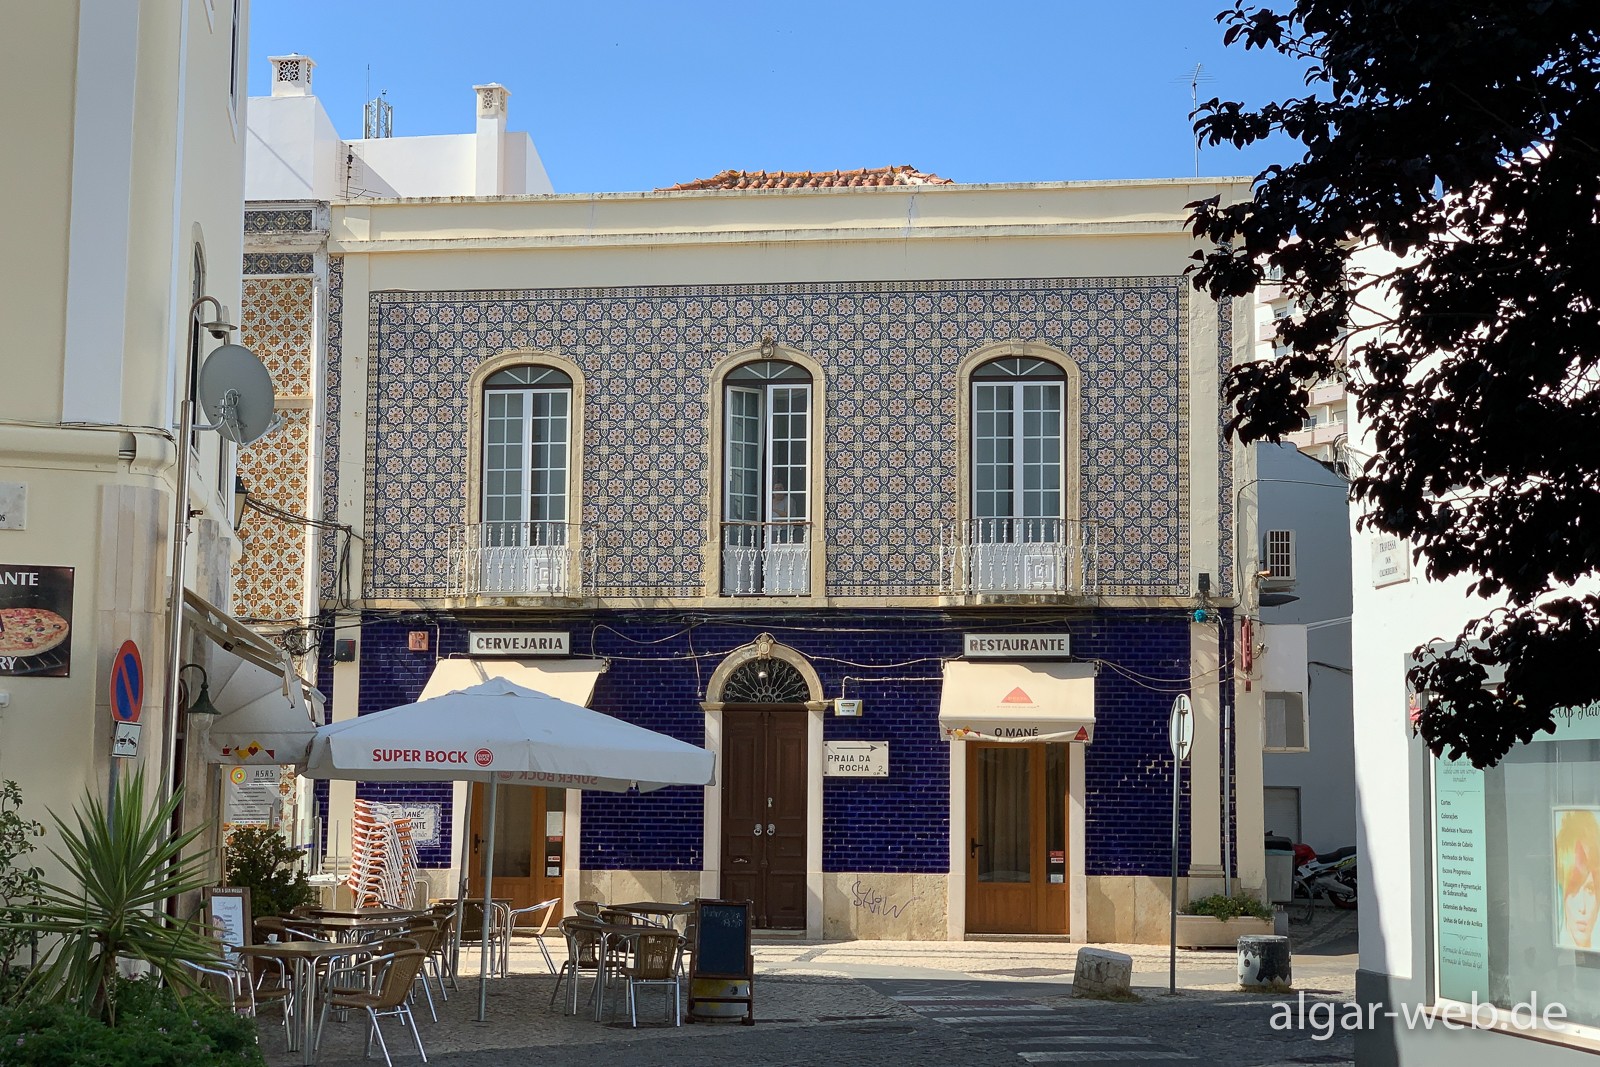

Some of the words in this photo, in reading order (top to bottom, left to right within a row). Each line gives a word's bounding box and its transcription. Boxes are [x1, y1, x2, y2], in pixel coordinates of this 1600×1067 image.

[476, 637, 563, 650] CERVEJARIA
[969, 639, 1065, 651] RESTAURANTE
[994, 727, 1002, 737] O
[1005, 726, 1039, 737] MANÉ
[372, 749, 421, 762] SUPER
[425, 750, 468, 764] BOCK
[827, 754, 855, 762] PRAIA
[858, 754, 871, 762] DA
[838, 764, 870, 772] ROCHA
